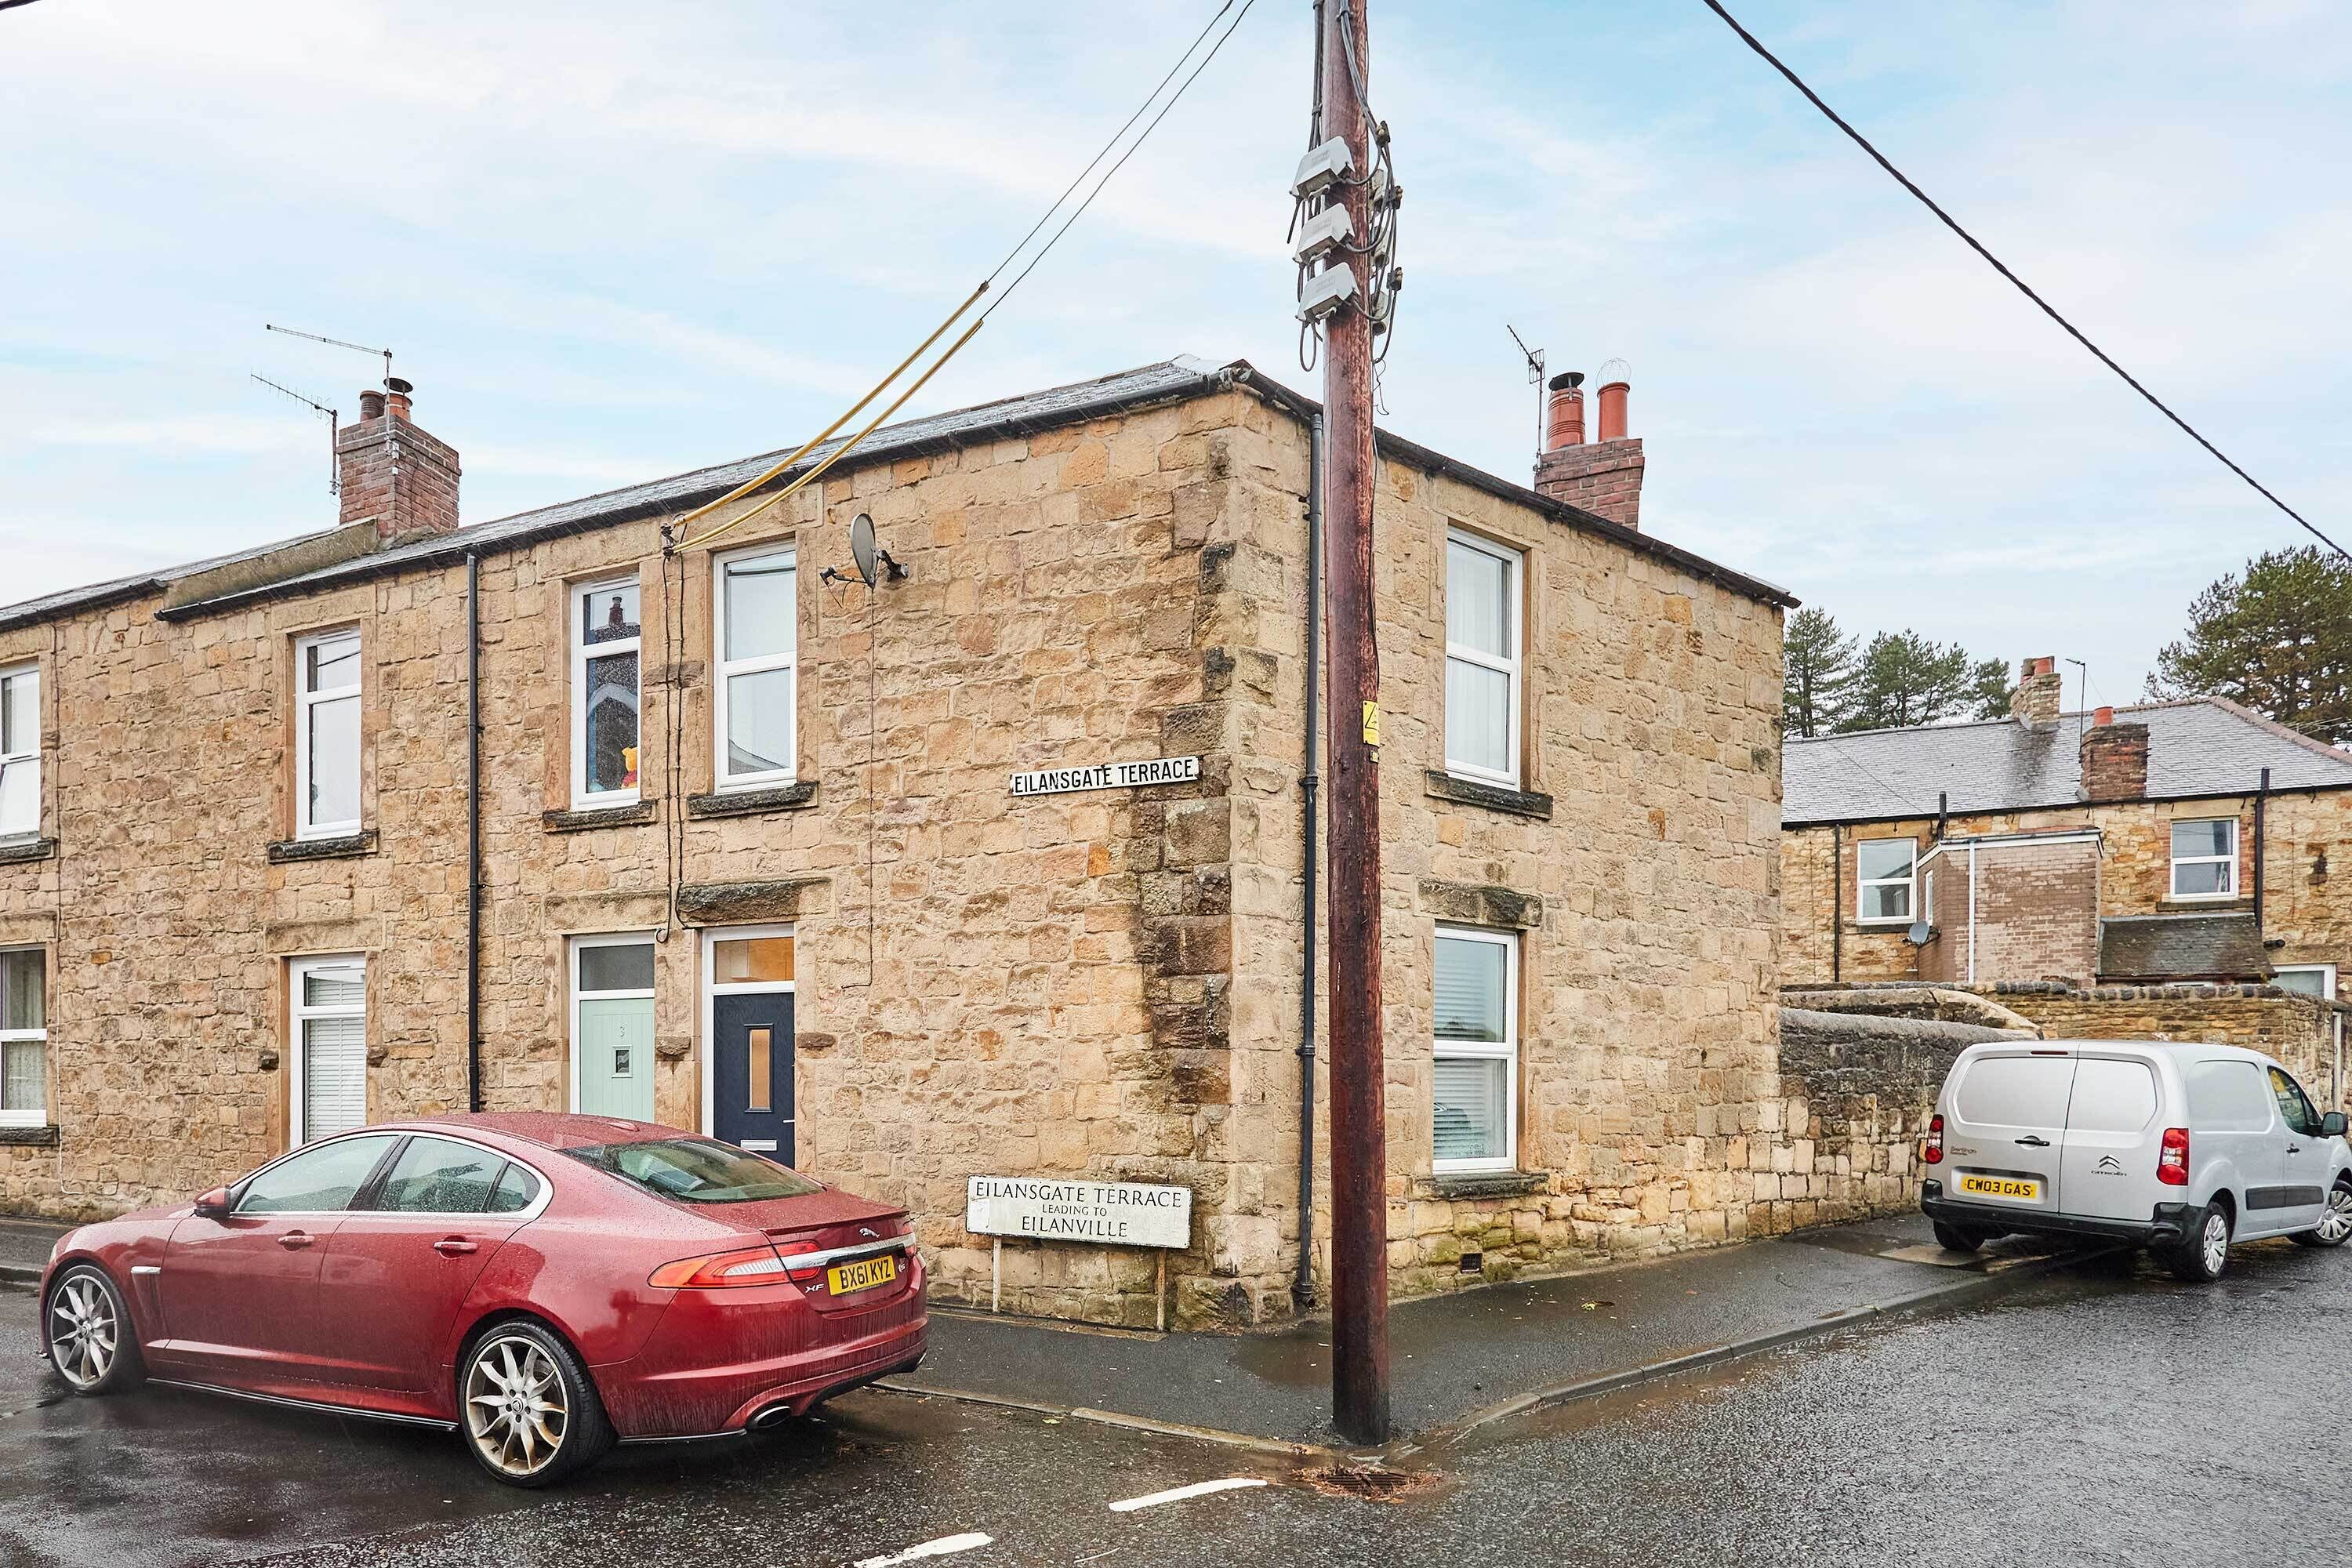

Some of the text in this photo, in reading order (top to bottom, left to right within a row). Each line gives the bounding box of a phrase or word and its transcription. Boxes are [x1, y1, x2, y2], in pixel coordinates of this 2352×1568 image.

[1014, 759, 1194, 794] EILANSGATE TERRACE
[975, 1181, 1182, 1208] EILANSGATE TERRACE
[1966, 1178, 2032, 1197] CW03 GAS
[1041, 1203, 1108, 1217] LEADING TO
[1022, 1215, 1128, 1238] EILANVILLE
[840, 1263, 870, 1290] BX61
[870, 1259, 891, 1281] KYZ
[804, 1283, 826, 1294] XF
